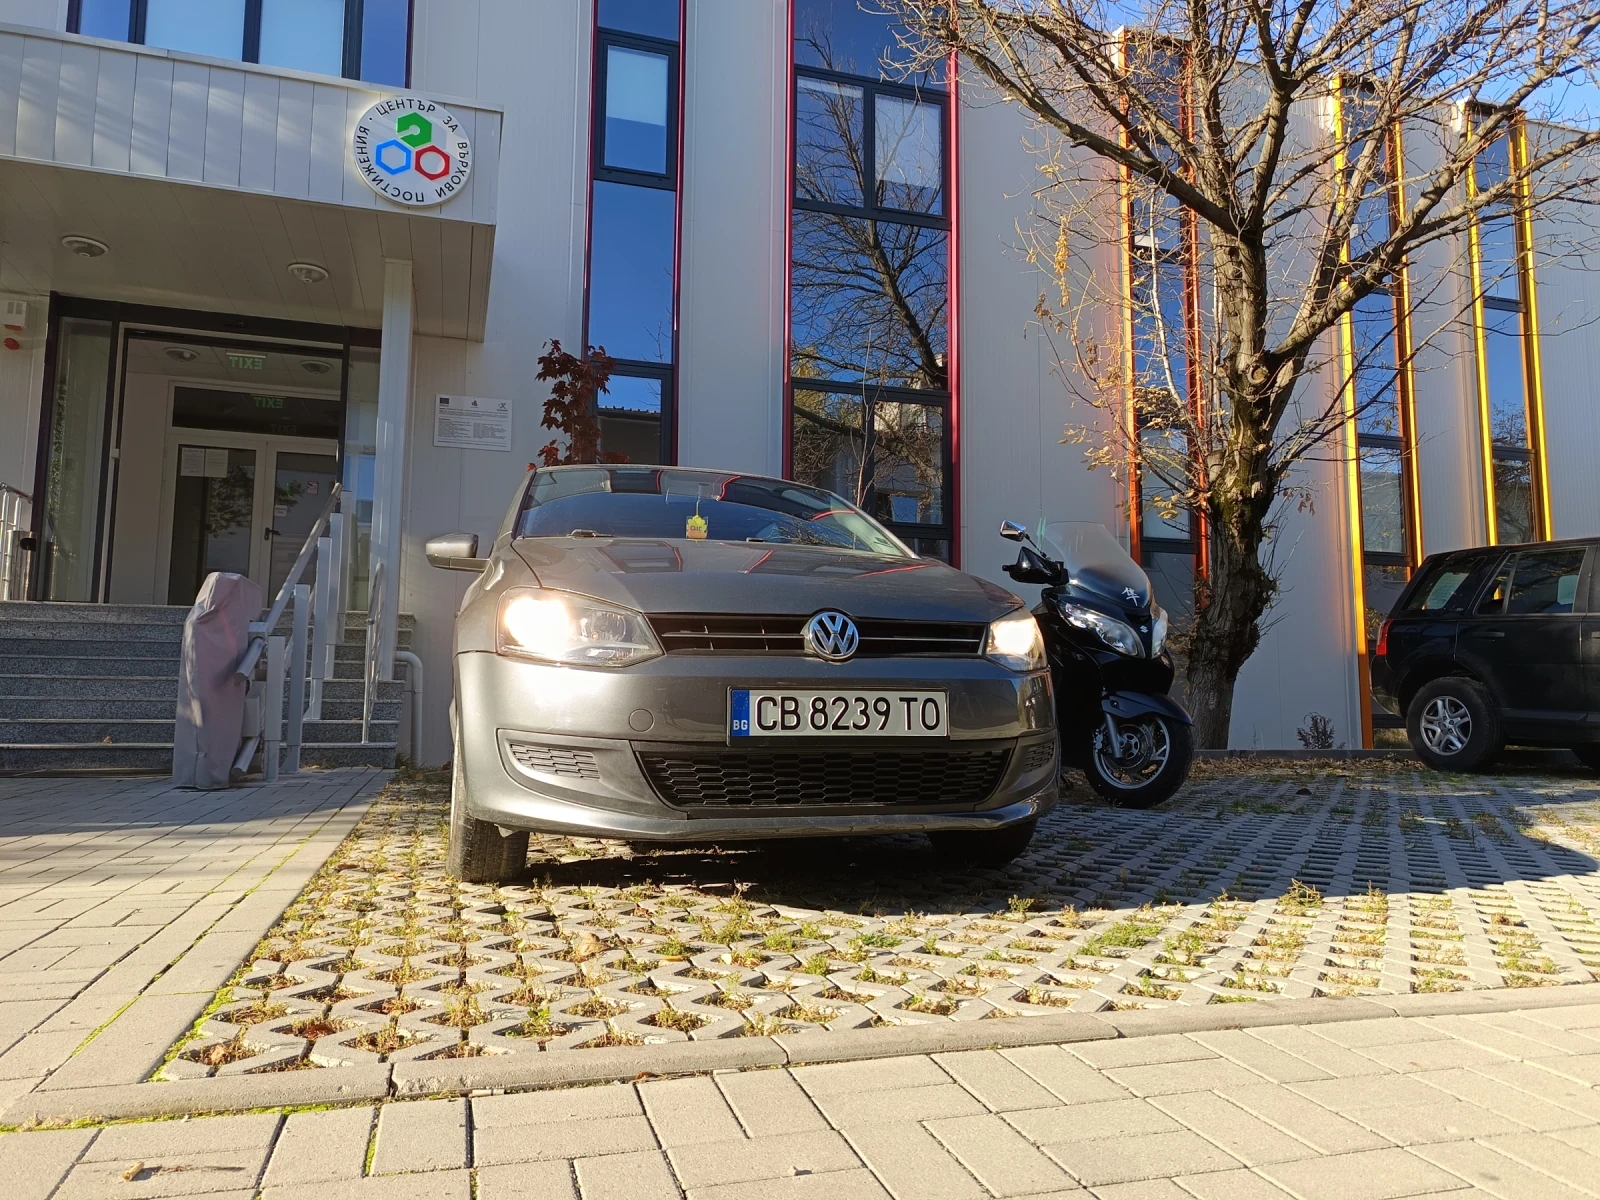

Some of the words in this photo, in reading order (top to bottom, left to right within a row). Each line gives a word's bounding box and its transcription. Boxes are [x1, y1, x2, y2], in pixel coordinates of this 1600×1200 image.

[376, 98, 436, 116] ЦЕНТЪР
[442, 116, 459, 133] ЗА
[356, 125, 425, 202] ПОСТИЖЕНИЯ
[435, 142, 469, 198] ВЪРХОВИ
[733, 719, 748, 731] BG
[756, 695, 801, 731] CB
[808, 695, 891, 731] 8239
[898, 696, 940, 731] TO
